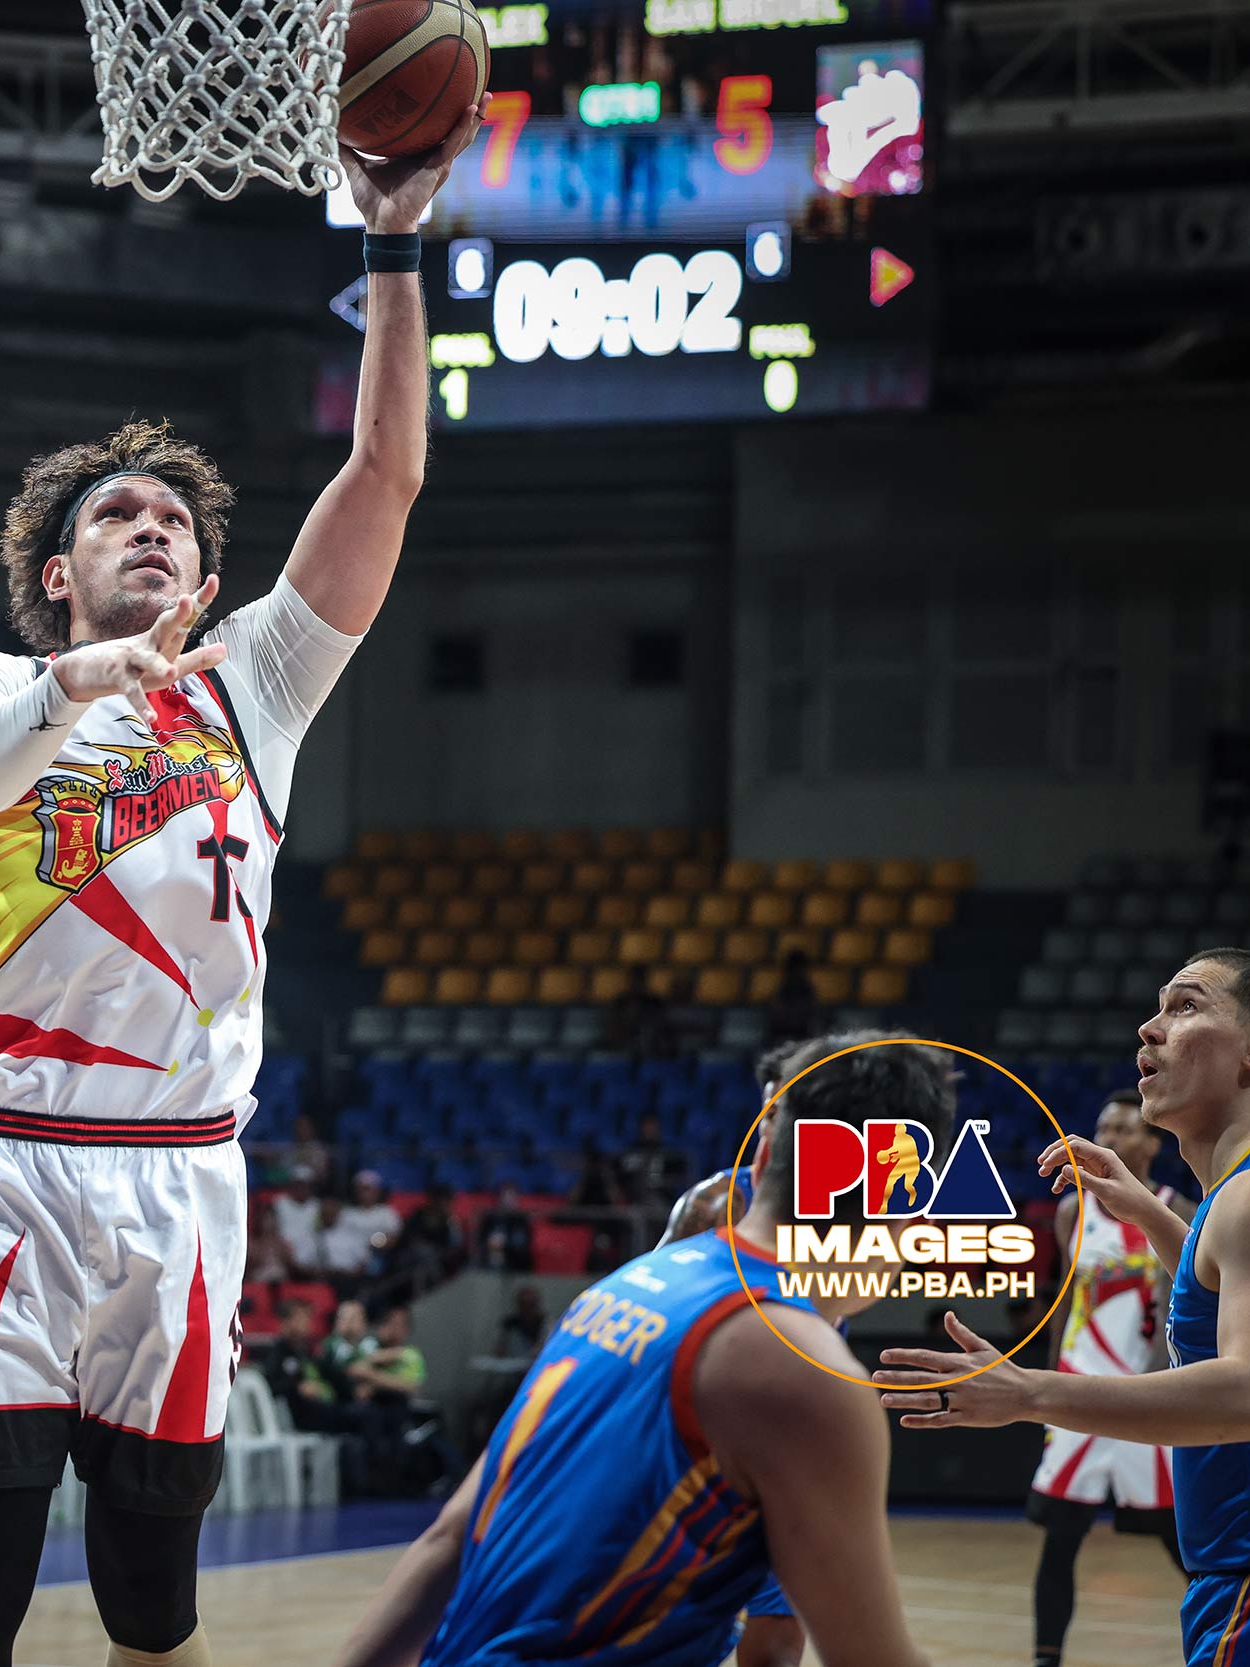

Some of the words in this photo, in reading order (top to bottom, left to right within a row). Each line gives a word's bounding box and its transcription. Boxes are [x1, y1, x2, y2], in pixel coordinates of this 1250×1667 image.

[482, 90, 531, 189] 7
[713, 74, 773, 176] 5
[493, 250, 743, 363] 09:02
[439, 368, 469, 420] 1
[106, 759, 151, 792] San
[146, 750, 212, 788] Miguel
[112, 767, 220, 849] BEERMEN
[472, 1354, 579, 1544] 1
